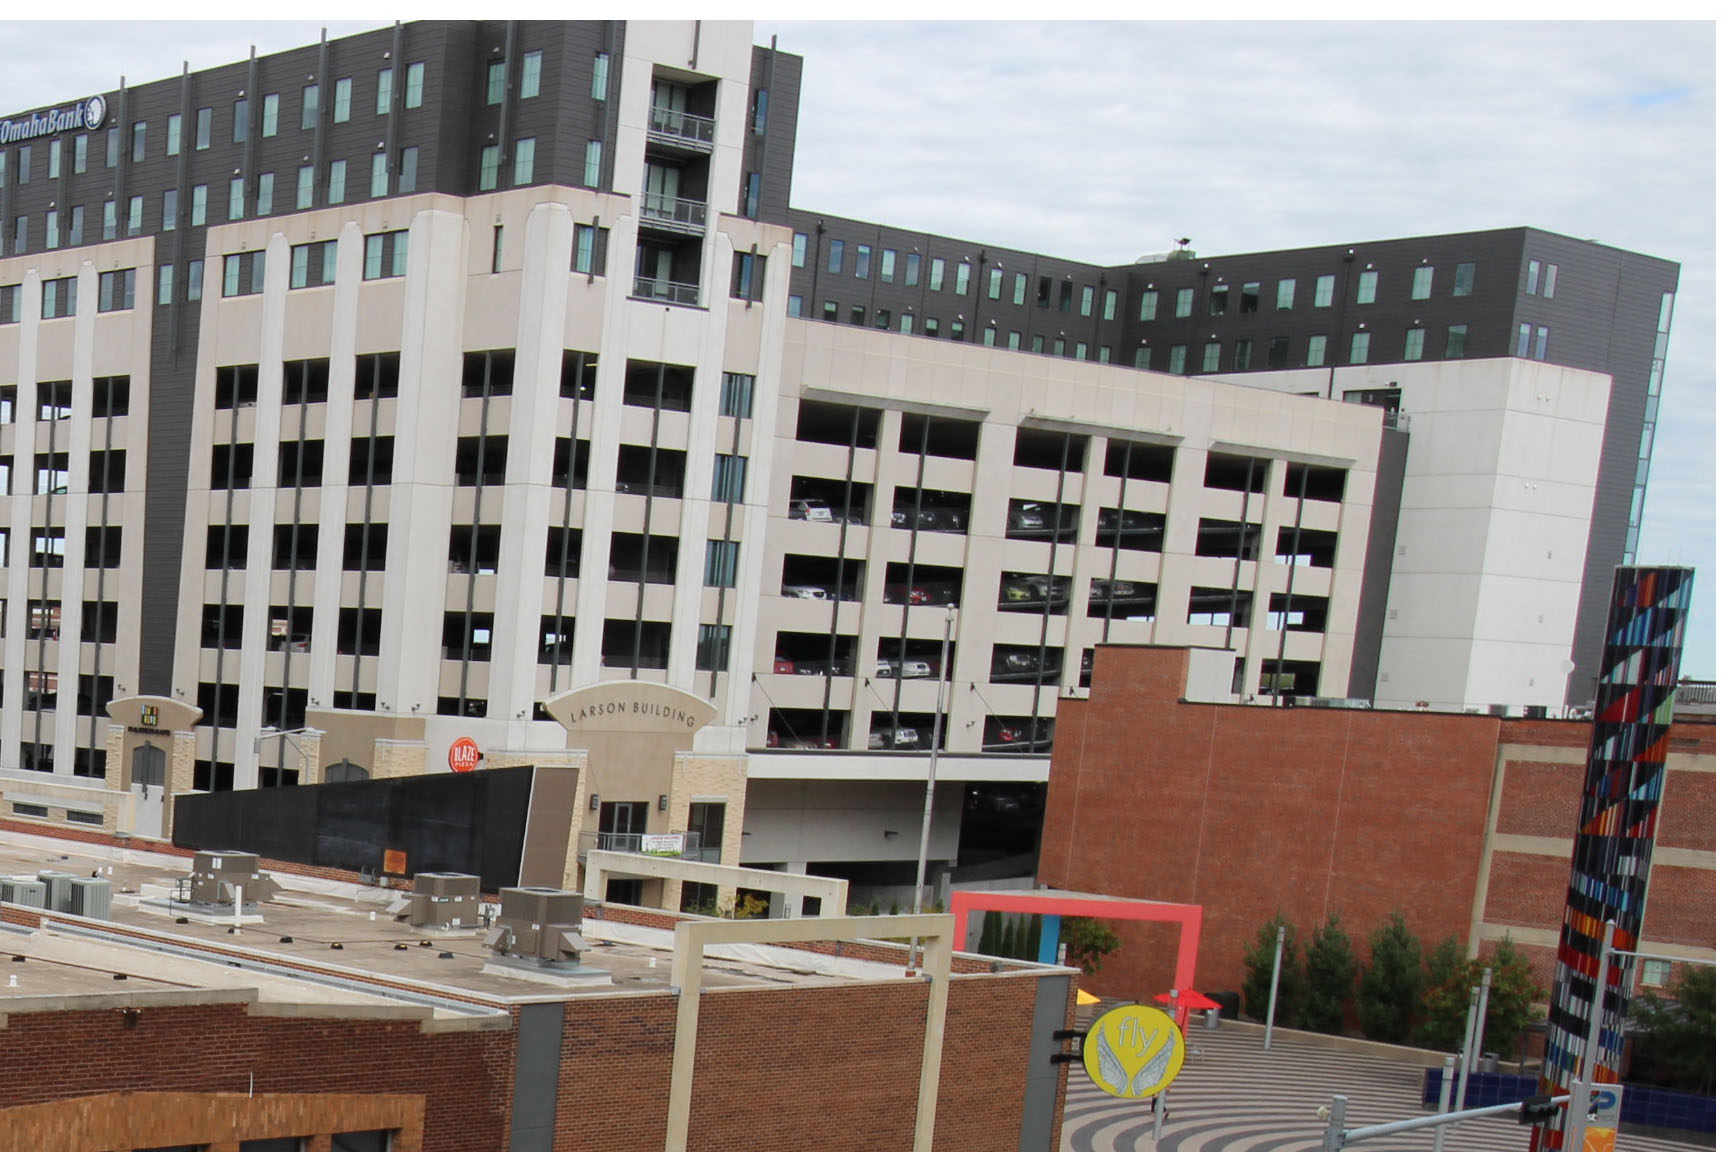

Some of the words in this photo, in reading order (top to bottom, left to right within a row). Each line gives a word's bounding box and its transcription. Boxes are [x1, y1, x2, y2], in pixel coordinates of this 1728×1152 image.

[570, 701, 626, 723] LARSON
[632, 702, 696, 728] BUILDING
[454, 745, 475, 762] BLAZE
[1118, 1015, 1160, 1057] fly
